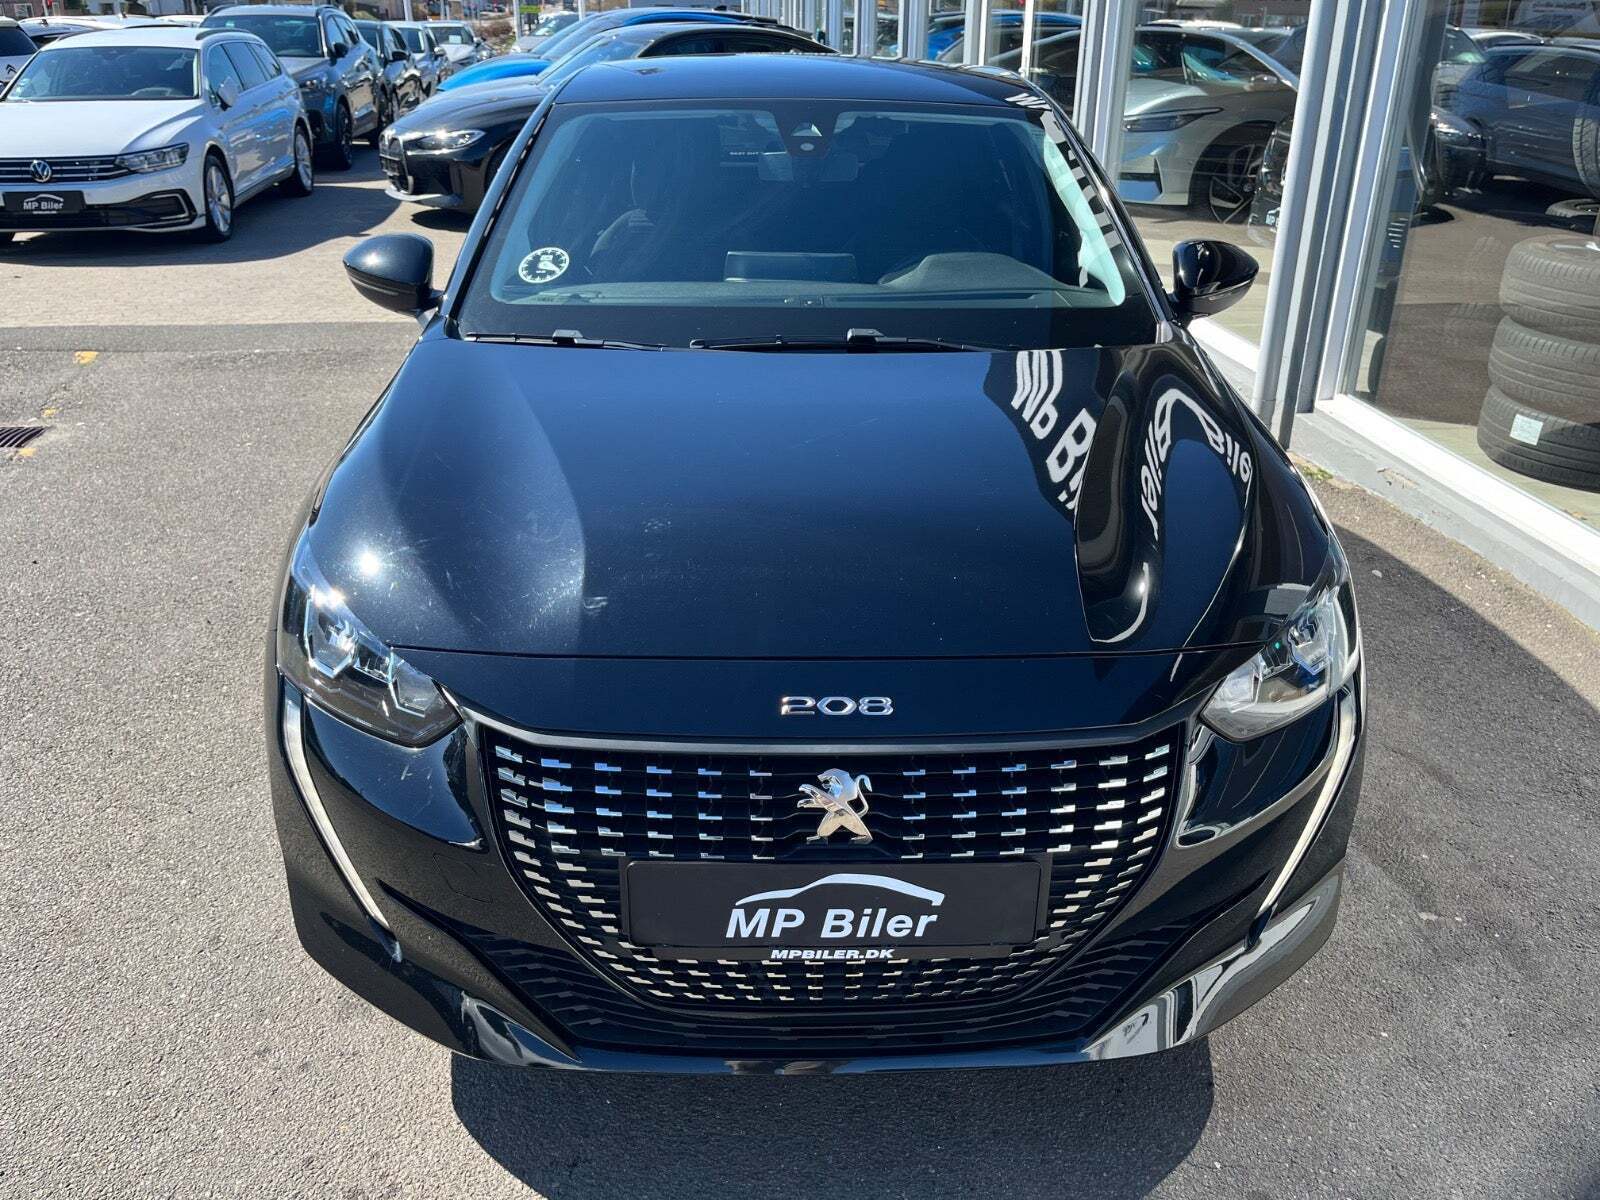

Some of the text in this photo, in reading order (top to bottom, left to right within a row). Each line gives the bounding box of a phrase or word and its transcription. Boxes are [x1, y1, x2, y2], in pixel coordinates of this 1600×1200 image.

[23, 201, 64, 210] MP Biler
[780, 696, 894, 716] 208
[725, 907, 938, 939] MP Biler
[770, 949, 895, 960] MPBILER.DK
